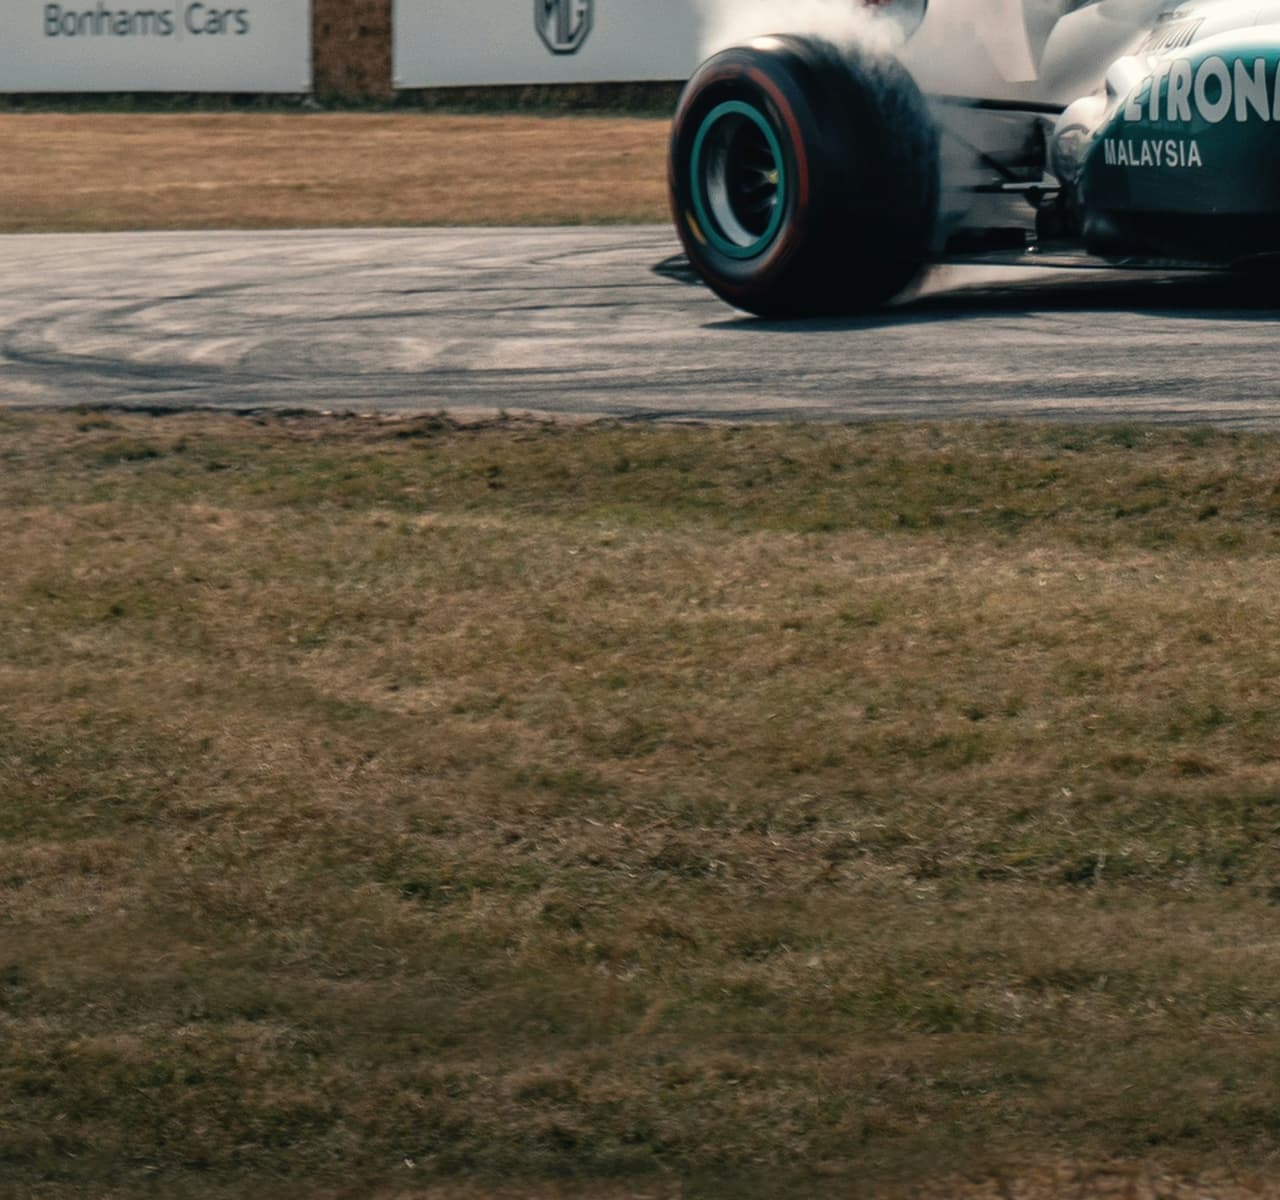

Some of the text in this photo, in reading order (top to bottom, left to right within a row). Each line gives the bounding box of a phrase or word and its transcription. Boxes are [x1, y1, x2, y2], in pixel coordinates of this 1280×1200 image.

[44, 2, 250, 37] Bonhams Cars
[1104, 138, 1202, 167] MALAYSIA
